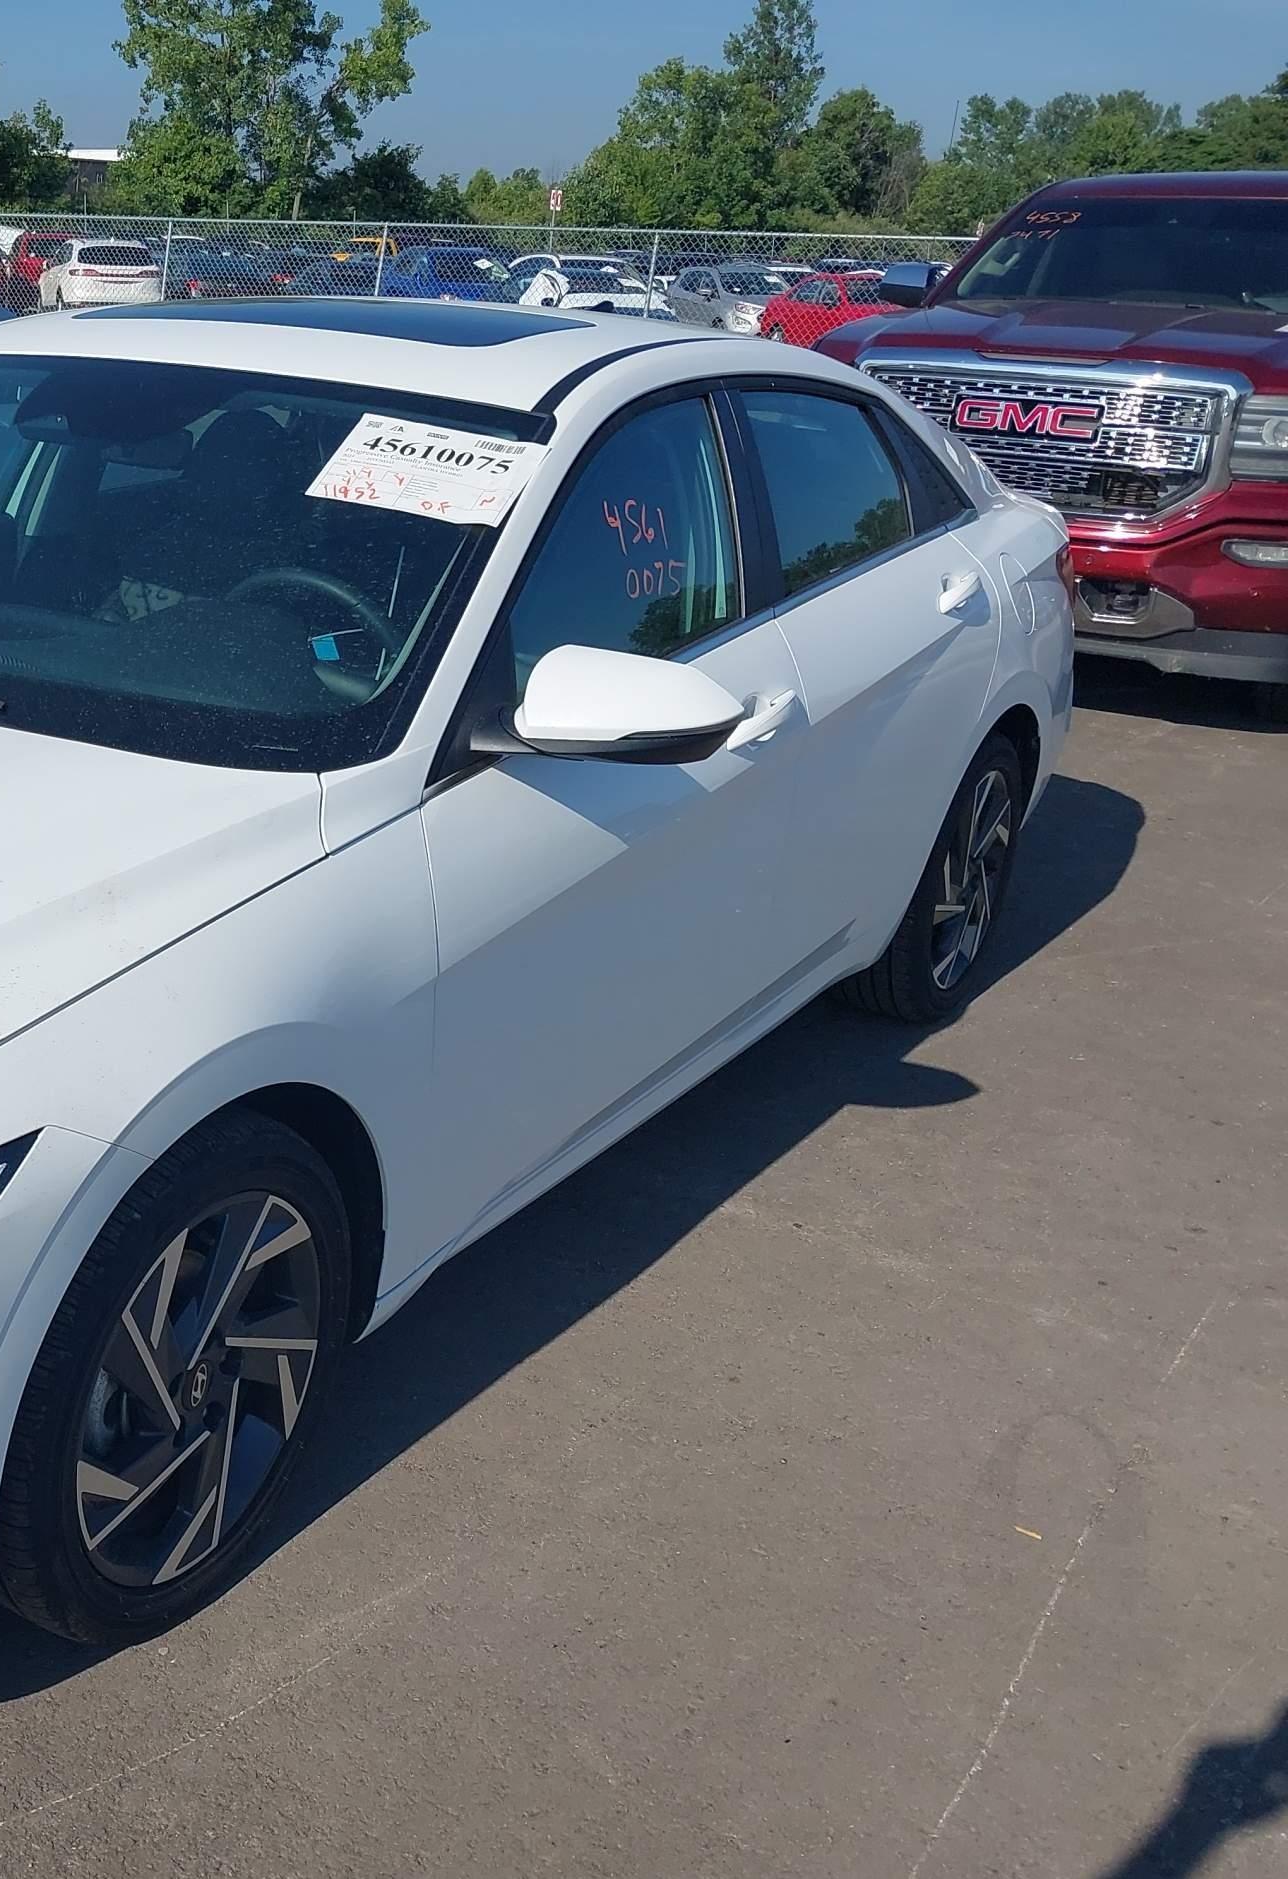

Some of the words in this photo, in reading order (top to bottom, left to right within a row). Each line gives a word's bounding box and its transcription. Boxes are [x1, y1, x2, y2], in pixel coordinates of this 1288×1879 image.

[956, 399, 1097, 438] GMC
[363, 436, 515, 475] 45610075
[603, 499, 669, 556] 4561
[626, 559, 686, 599] 0075
